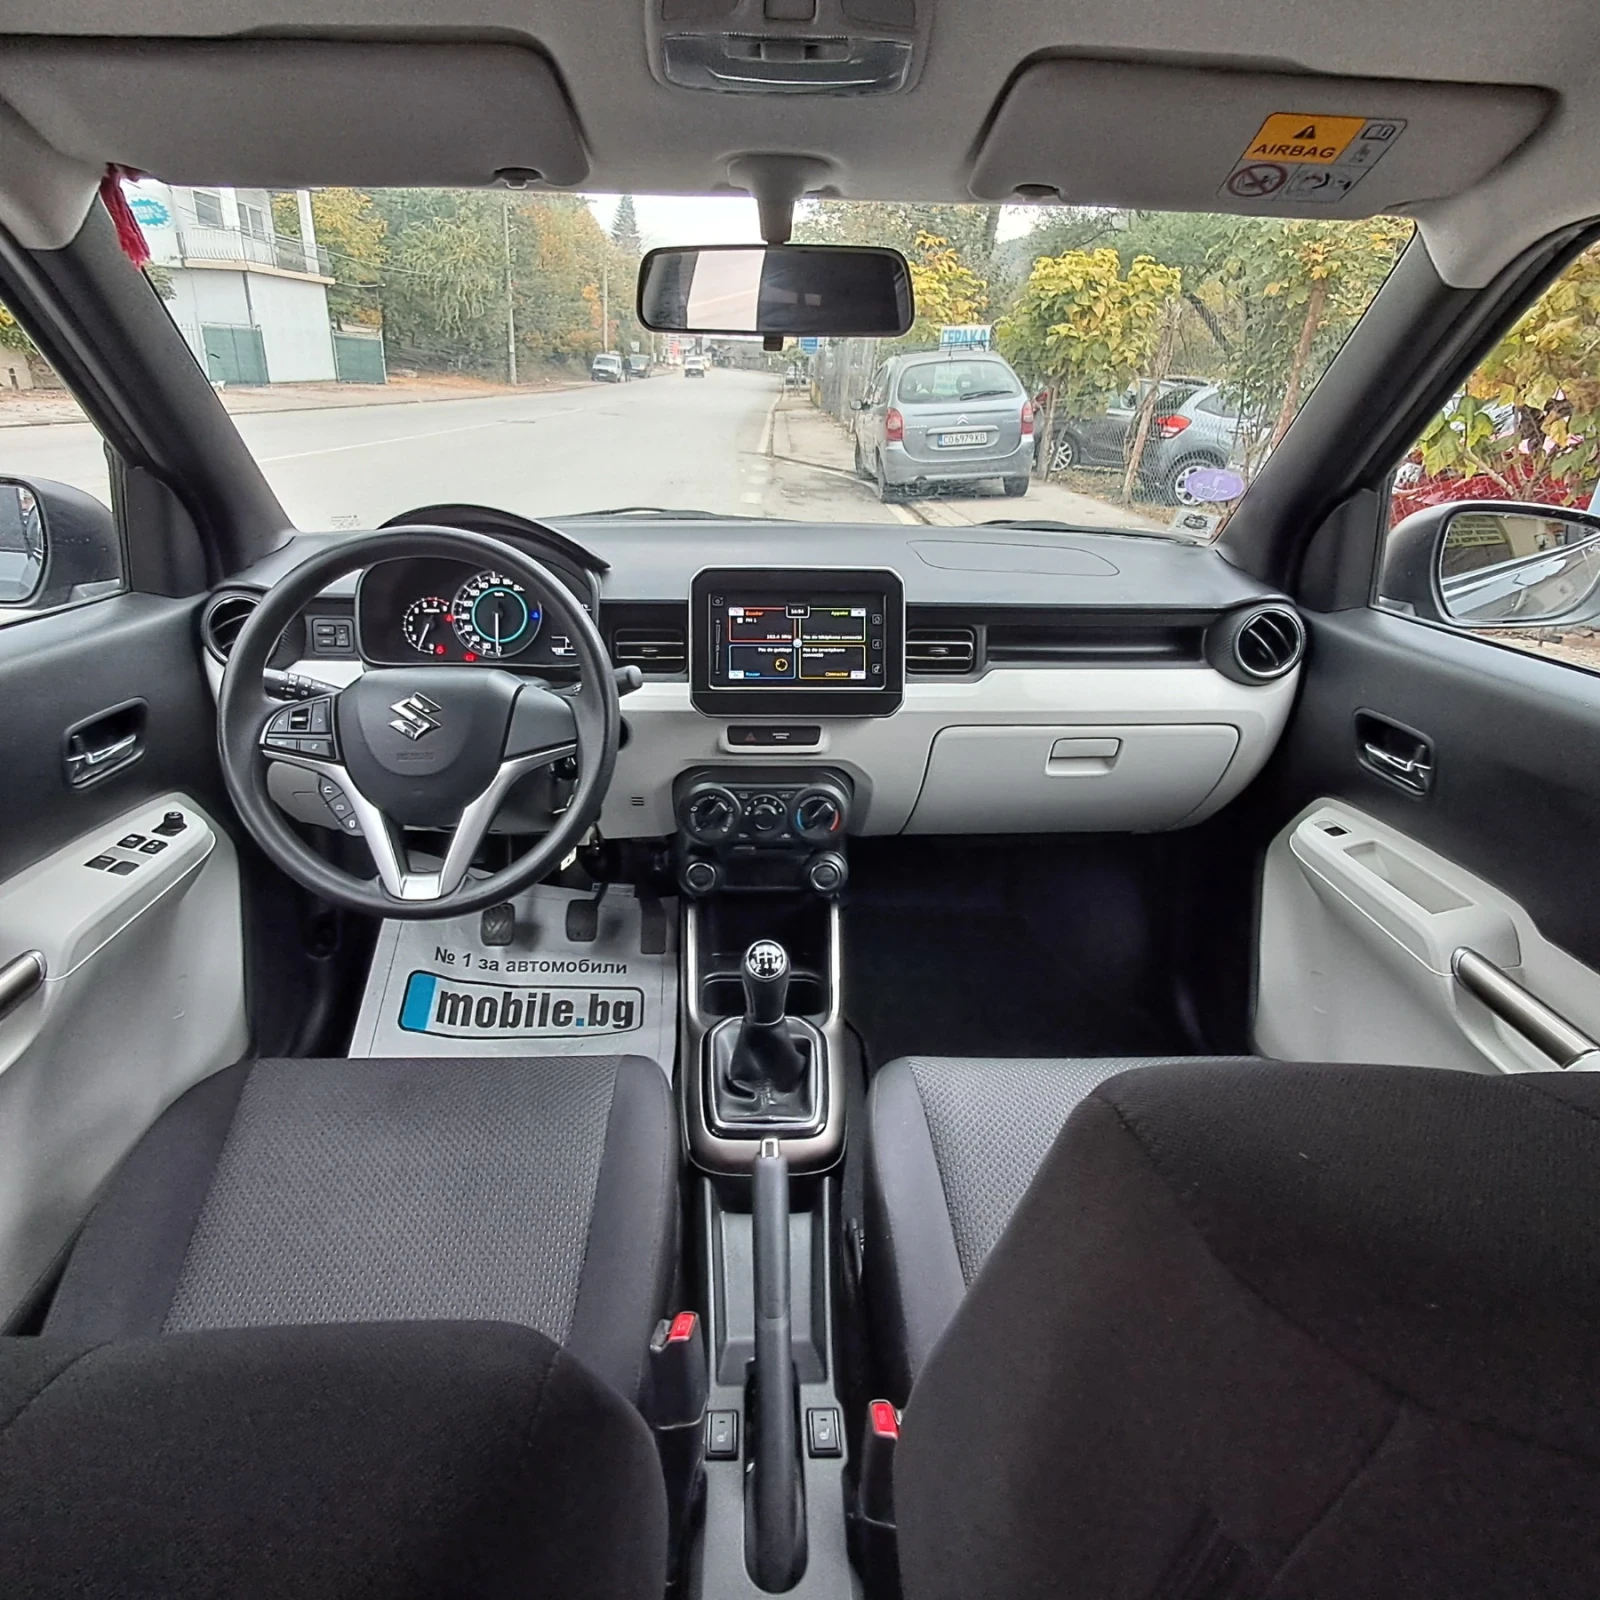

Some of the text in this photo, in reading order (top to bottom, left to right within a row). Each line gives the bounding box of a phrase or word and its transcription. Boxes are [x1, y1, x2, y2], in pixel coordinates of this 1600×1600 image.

[1253, 143, 1336, 158] AIRBAG
[434, 946, 628, 974] № 1 за автомобили
[435, 990, 635, 1030] mobile.bg
